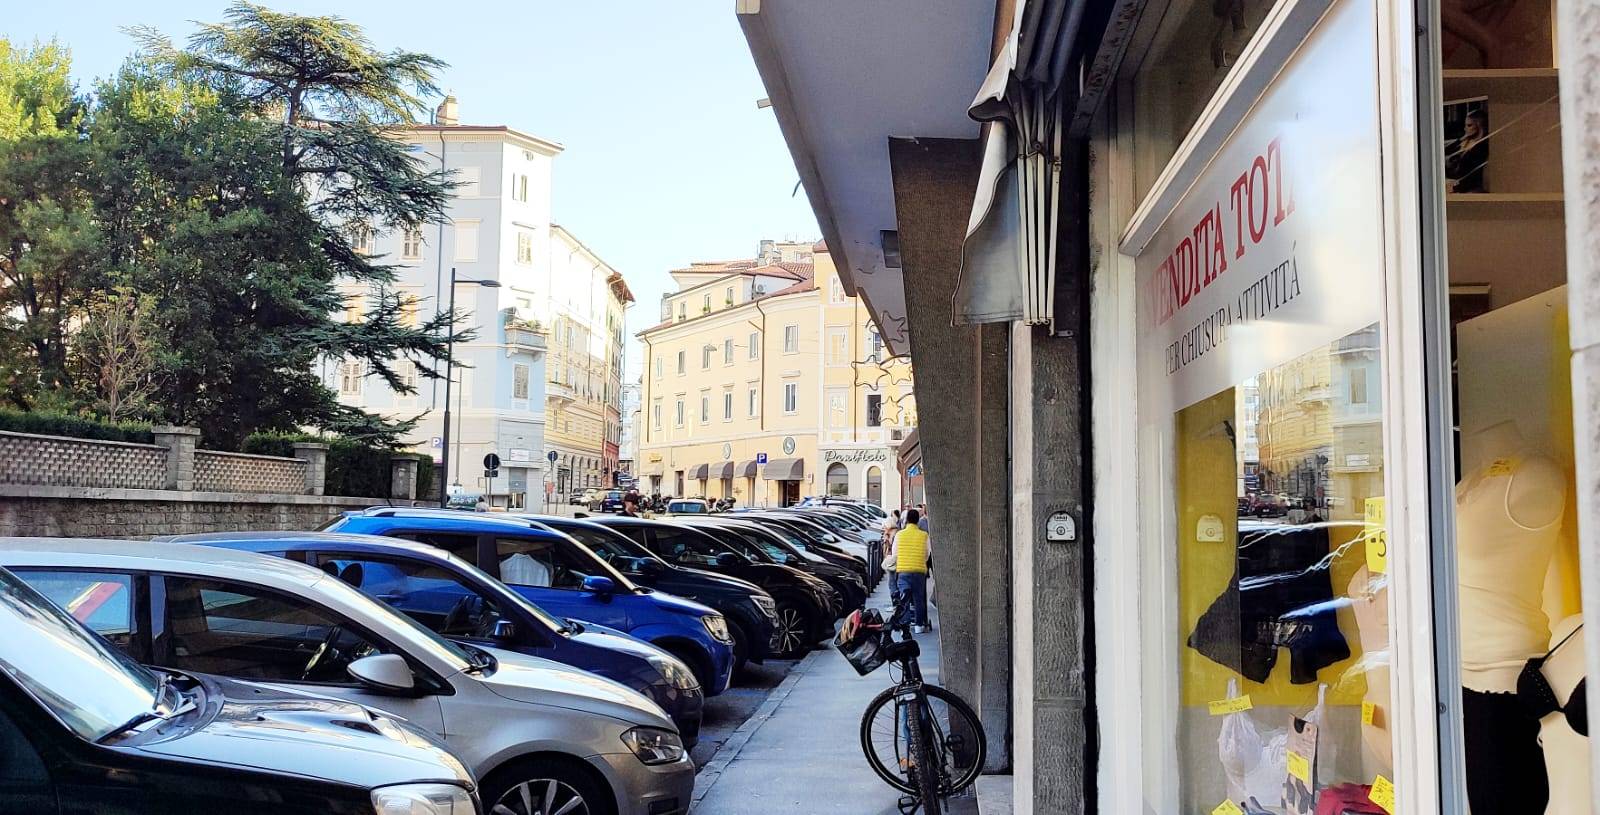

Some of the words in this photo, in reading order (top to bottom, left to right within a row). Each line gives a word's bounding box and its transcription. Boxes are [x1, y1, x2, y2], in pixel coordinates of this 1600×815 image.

[1146, 201, 1227, 326] VENDITA
[1165, 341, 1181, 377] PER
[758, 454, 766, 463] P
